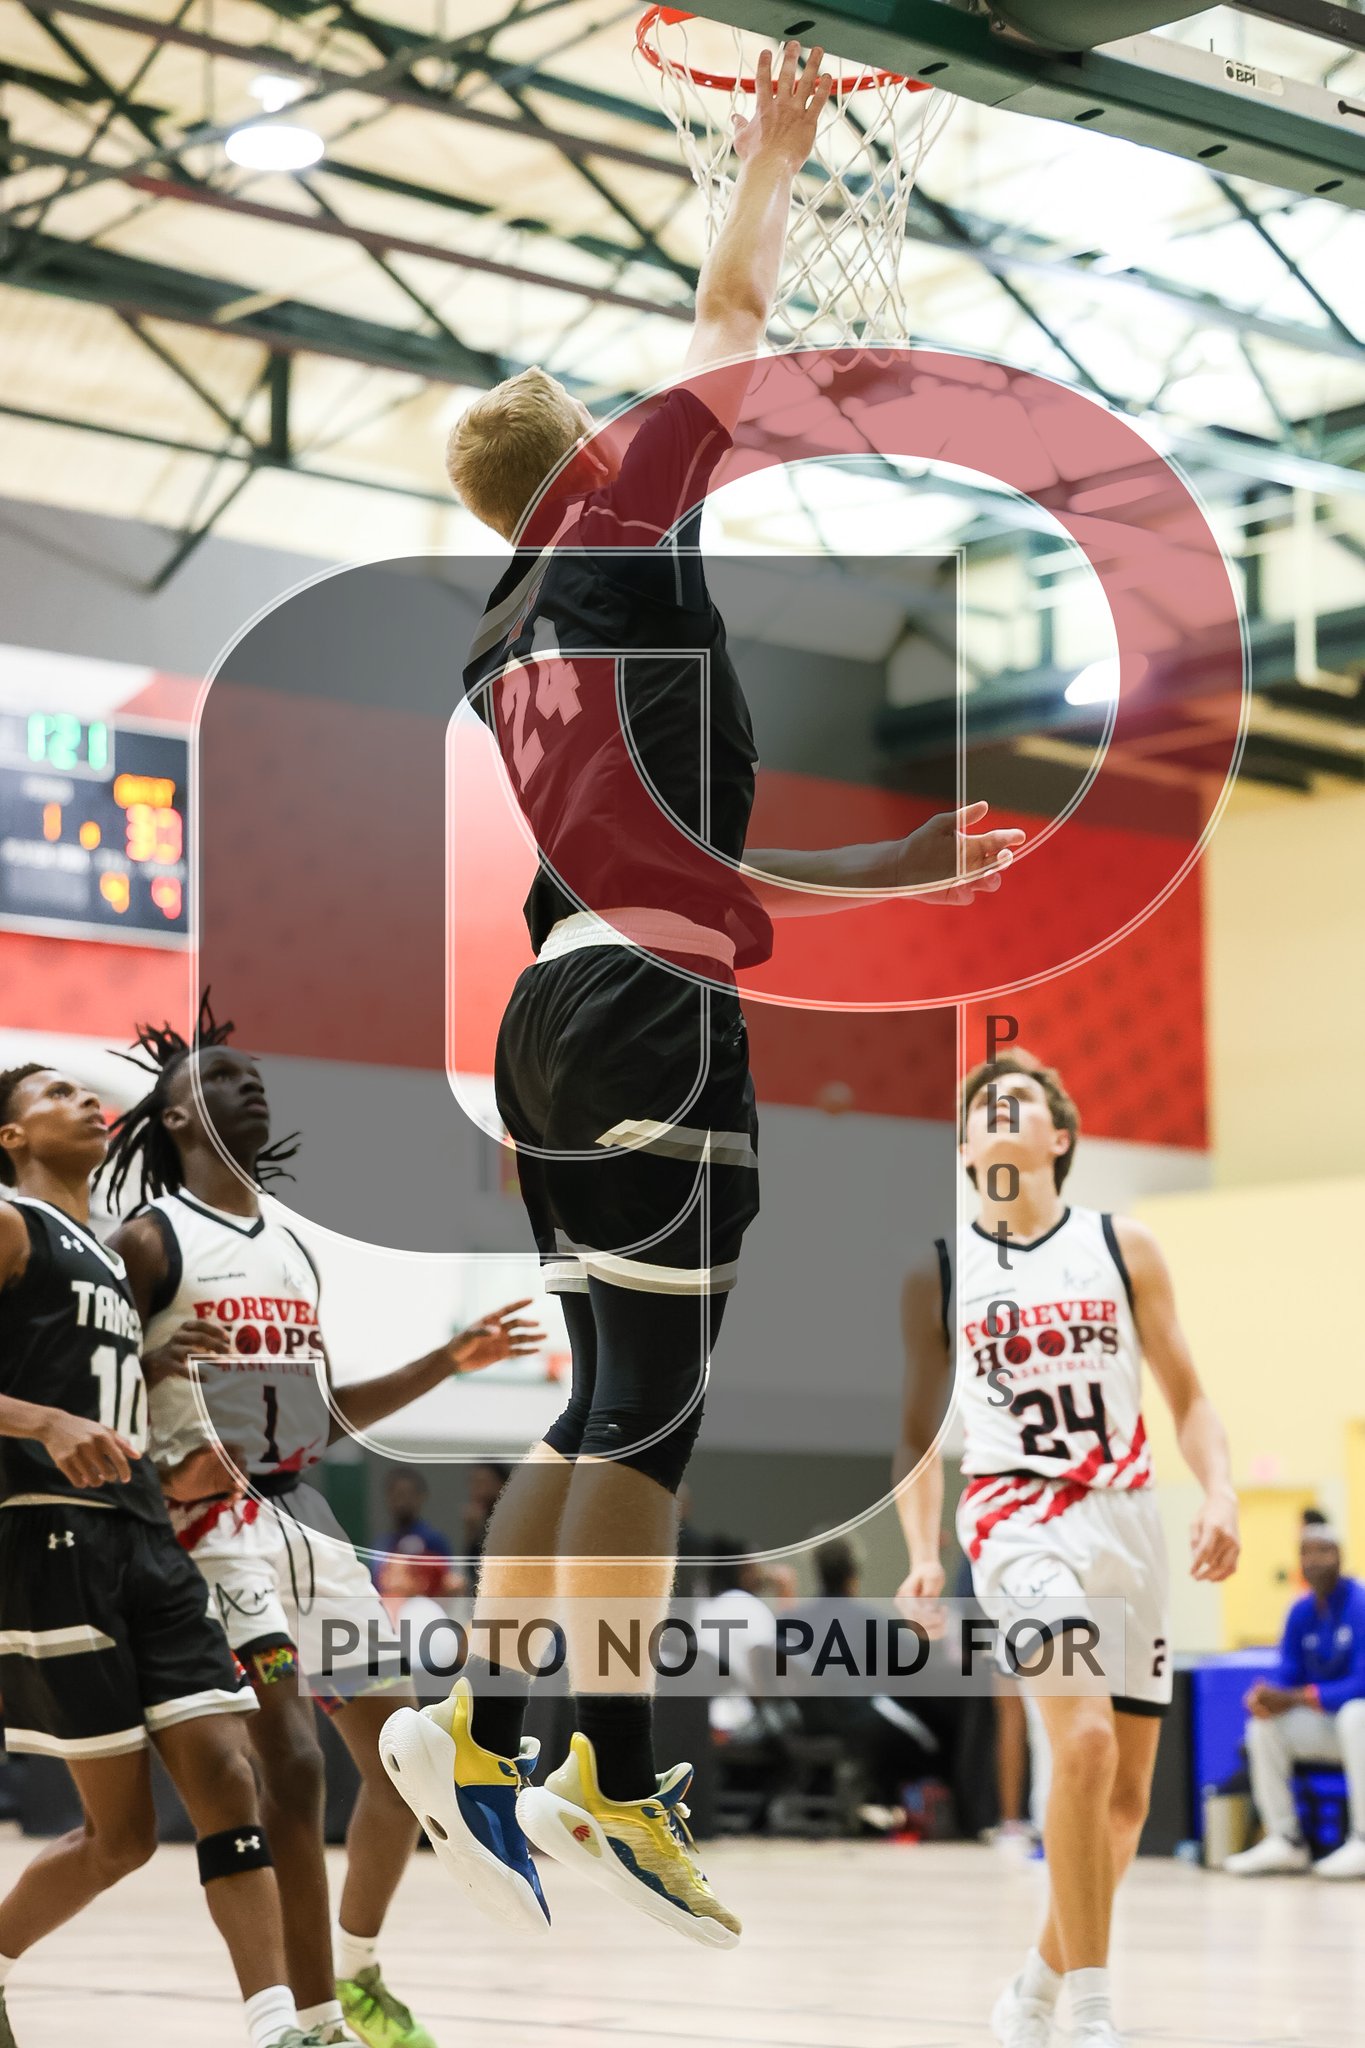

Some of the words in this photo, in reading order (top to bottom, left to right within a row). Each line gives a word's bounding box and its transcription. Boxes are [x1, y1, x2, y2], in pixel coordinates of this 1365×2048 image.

[501, 614, 583, 794] 24
[963, 1300, 1118, 1348] FOREVER
[973, 1325, 1119, 1377] HOOPS
[91, 1344, 148, 1453] 10
[259, 1384, 281, 1464] 1
[1009, 1382, 1114, 1464] 24
